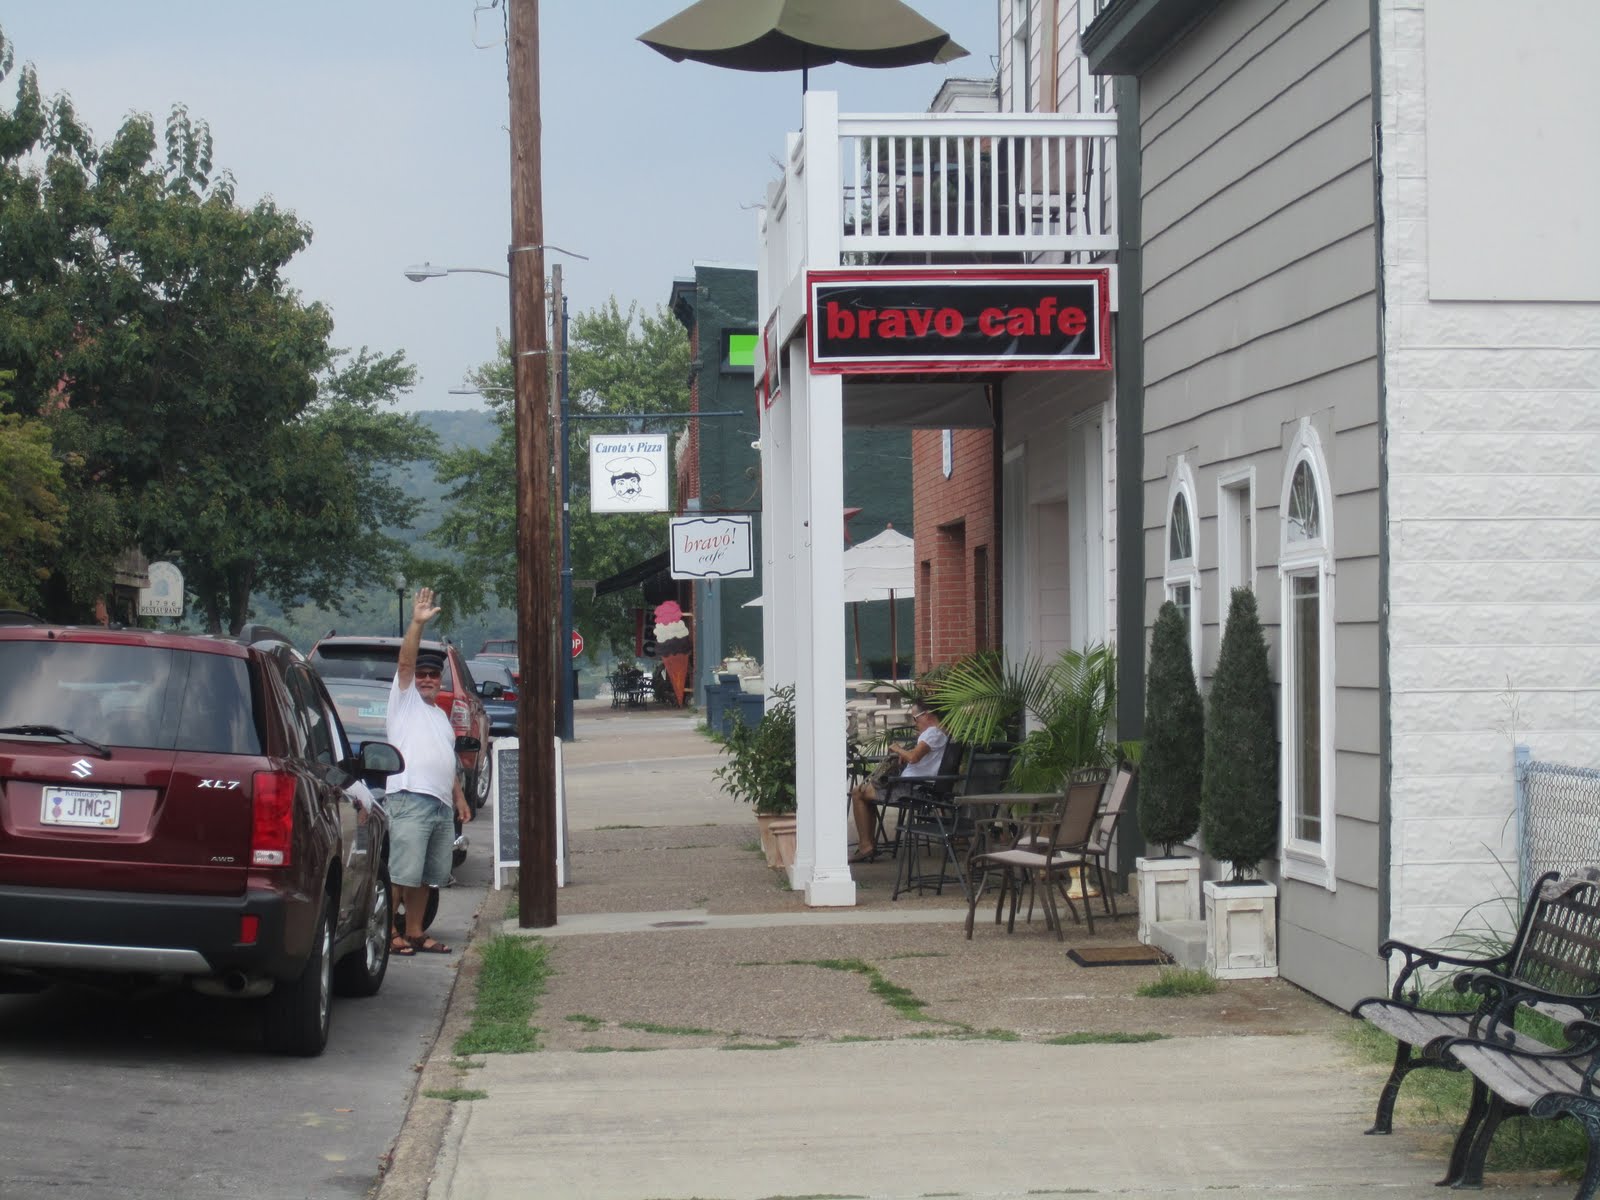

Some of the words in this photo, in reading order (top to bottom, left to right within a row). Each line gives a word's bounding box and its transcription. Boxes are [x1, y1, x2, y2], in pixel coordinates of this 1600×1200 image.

[826, 301, 964, 340] bravo
[978, 296, 1087, 338] cafe
[595, 442, 634, 453] Carota's
[637, 442, 662, 453] Pizza
[197, 778, 241, 790] XL7
[65, 790, 99, 798] Kentucky
[67, 798, 111, 818] JTMC2
